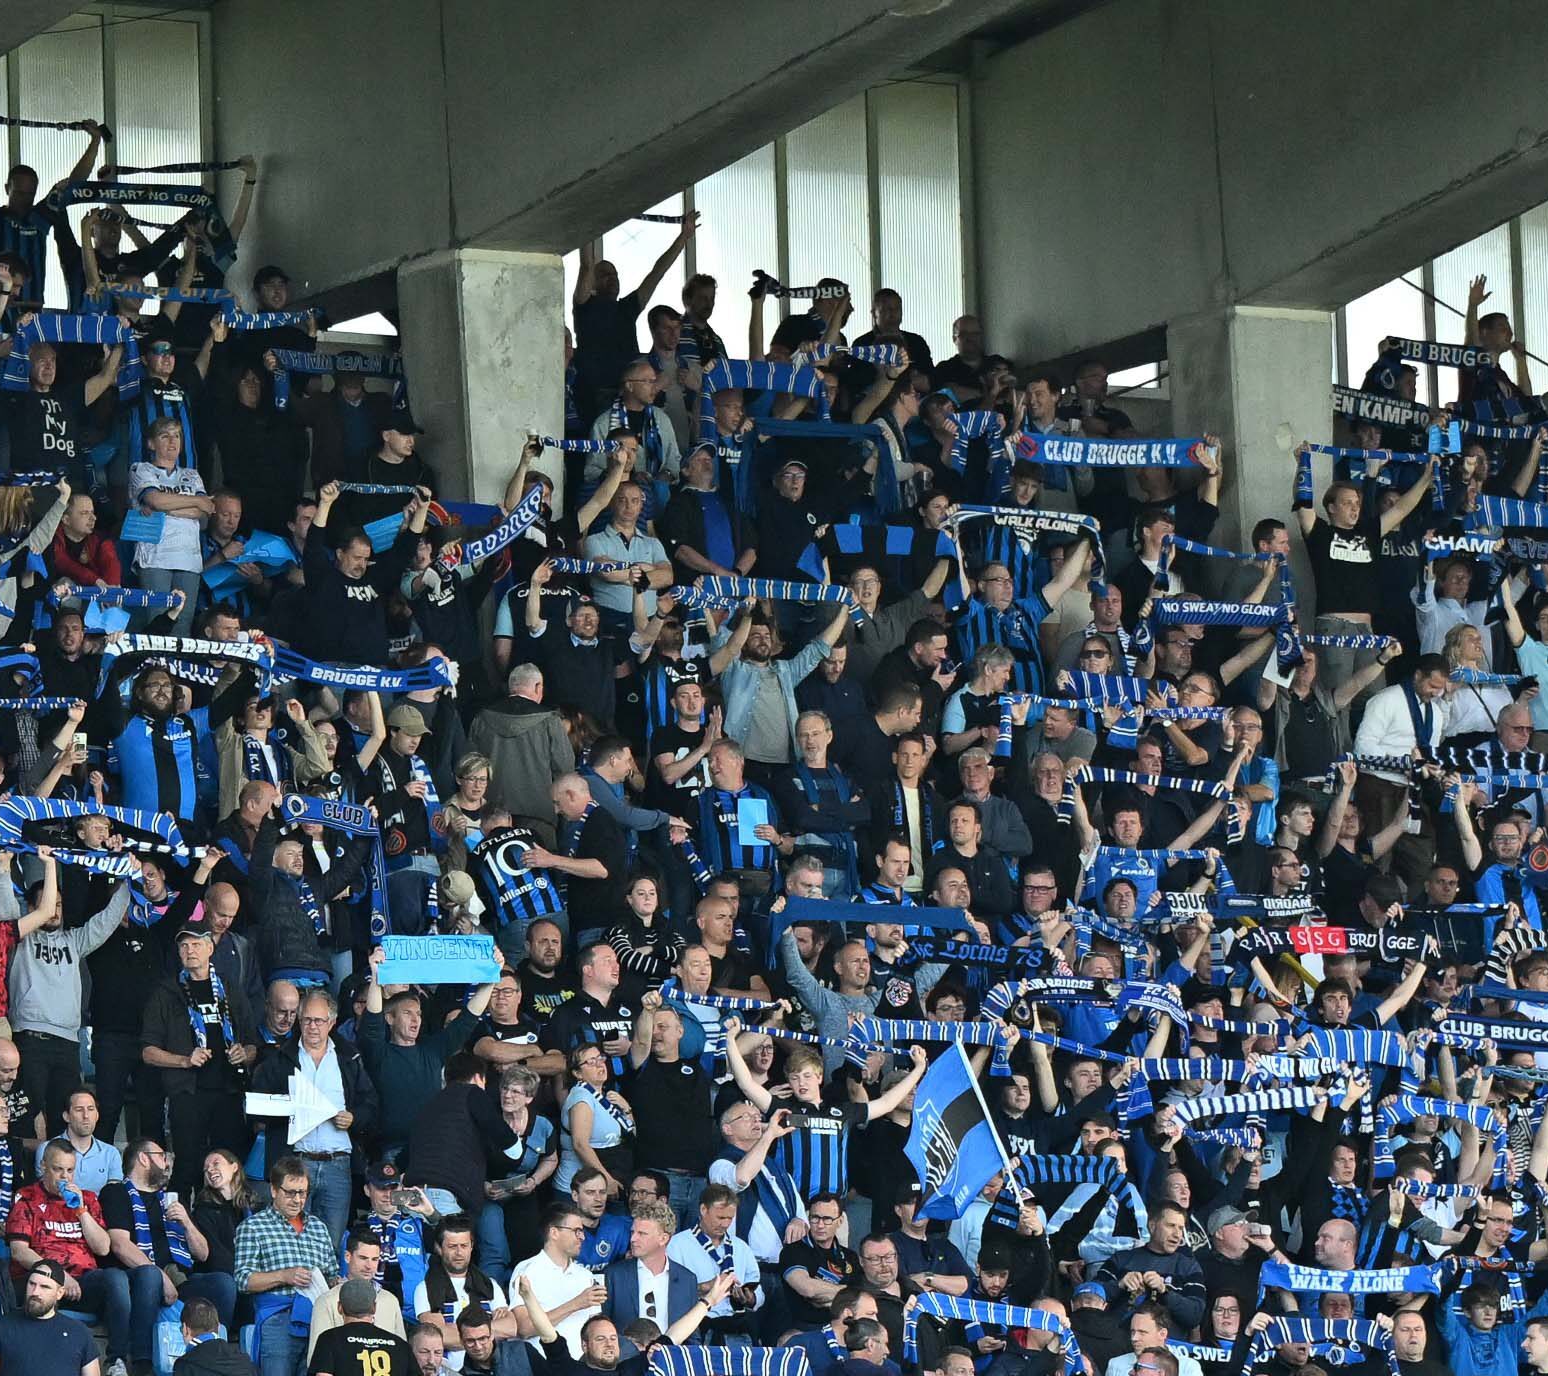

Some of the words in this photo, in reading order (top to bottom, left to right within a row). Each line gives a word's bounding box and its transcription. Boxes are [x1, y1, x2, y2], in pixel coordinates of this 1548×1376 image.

[46, 414, 67, 436] My
[44, 433, 75, 458] Dog
[1044, 439, 1082, 463] CLUB
[1086, 441, 1147, 464] BRUGGE
[181, 636, 265, 661] BRUGES
[311, 666, 377, 688] BRUGGE
[383, 937, 494, 961] VINCENT
[1439, 1019, 1486, 1038] CLUB
